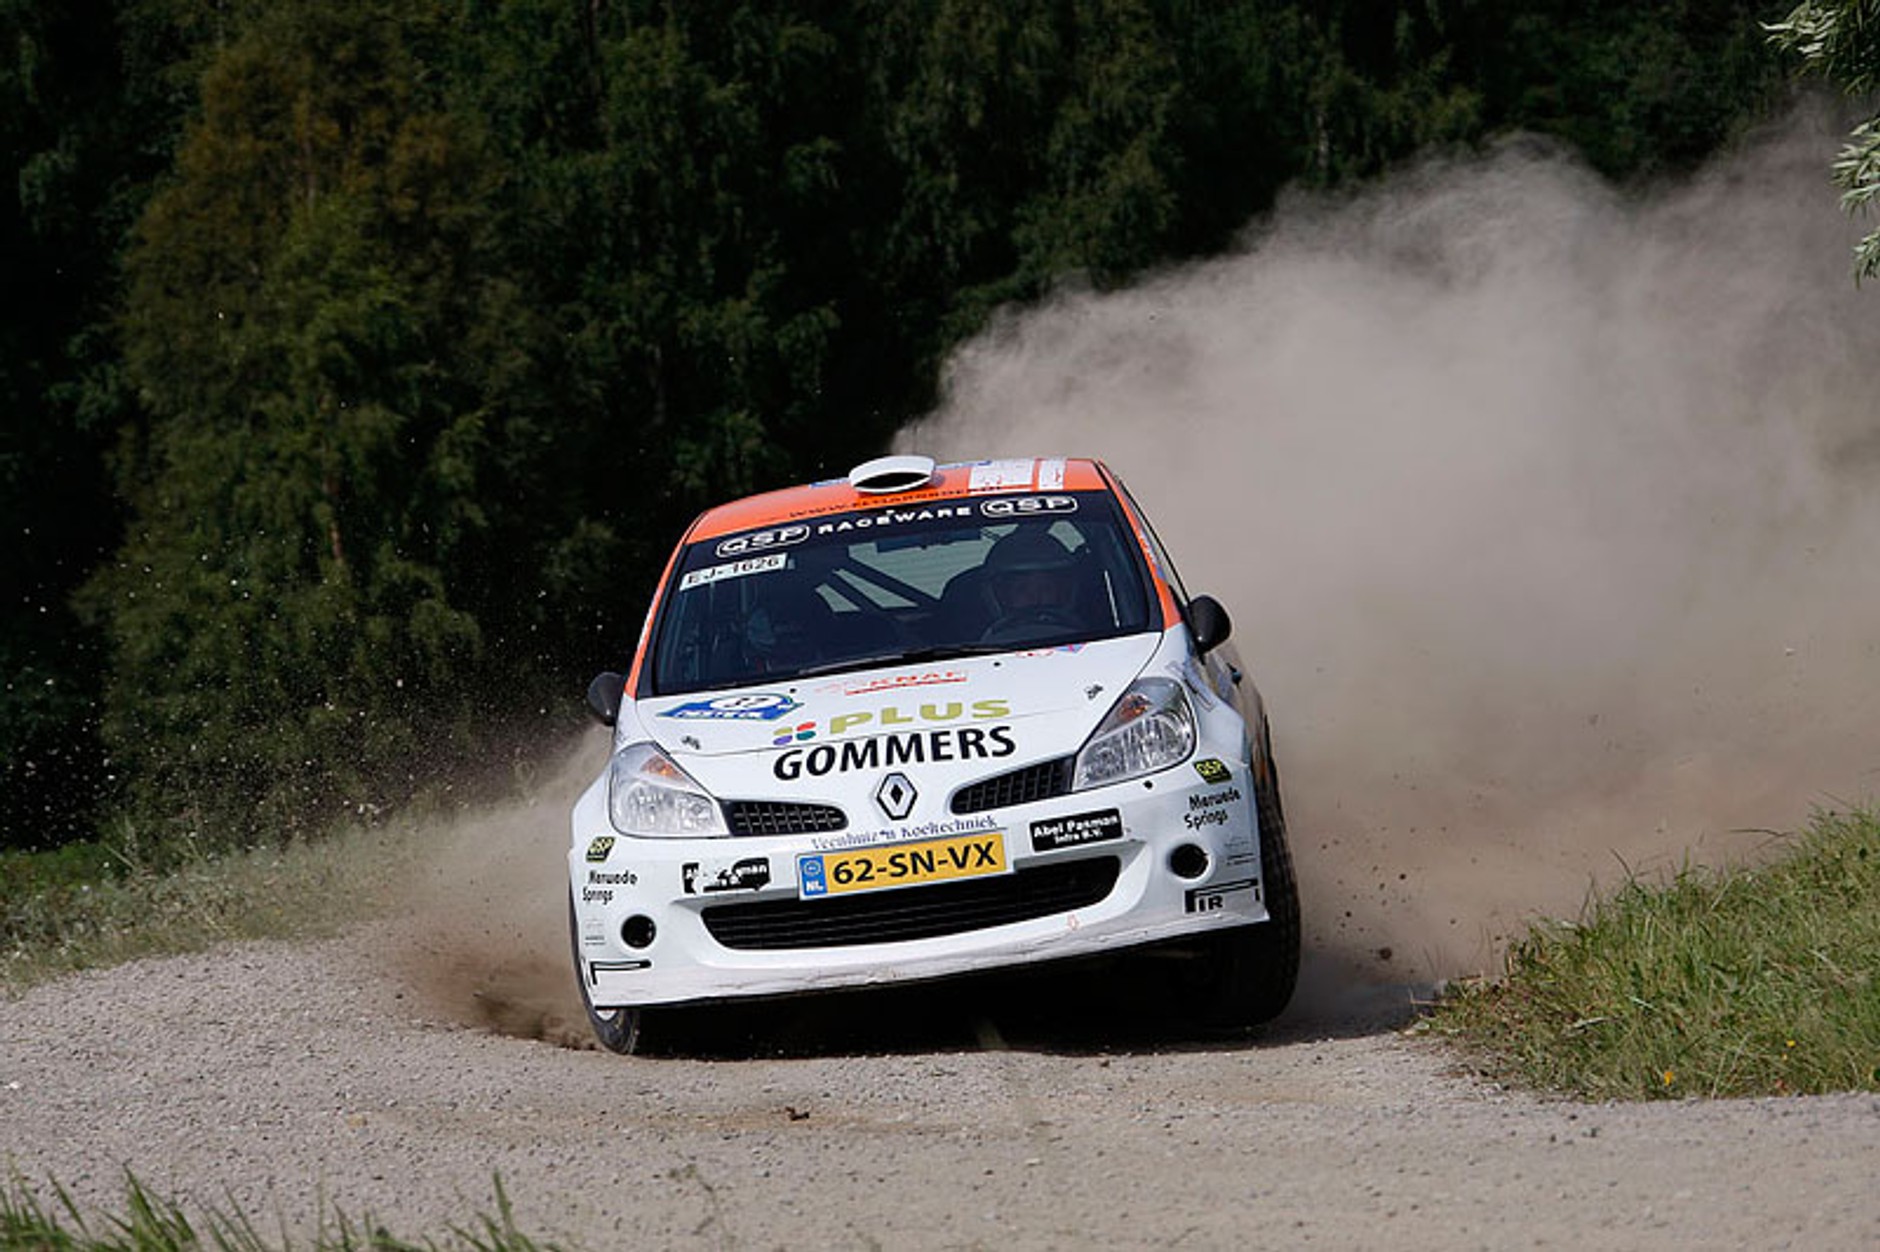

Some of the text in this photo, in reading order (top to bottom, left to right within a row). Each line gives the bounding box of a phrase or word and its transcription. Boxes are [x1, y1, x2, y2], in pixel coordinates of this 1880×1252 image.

[721, 526, 803, 553] QSP
[818, 507, 971, 535] RACEWARE
[987, 497, 1070, 513] QSP
[687, 557, 780, 584] EJ-1626
[829, 699, 1011, 735] PLUS
[773, 725, 1016, 781] GOMMERS
[1034, 822, 1064, 838] Abel
[1183, 809, 1228, 831] Springs
[832, 841, 998, 885] 62-SN-VX
[582, 886, 614, 905] Springs
[805, 880, 824, 892] NL
